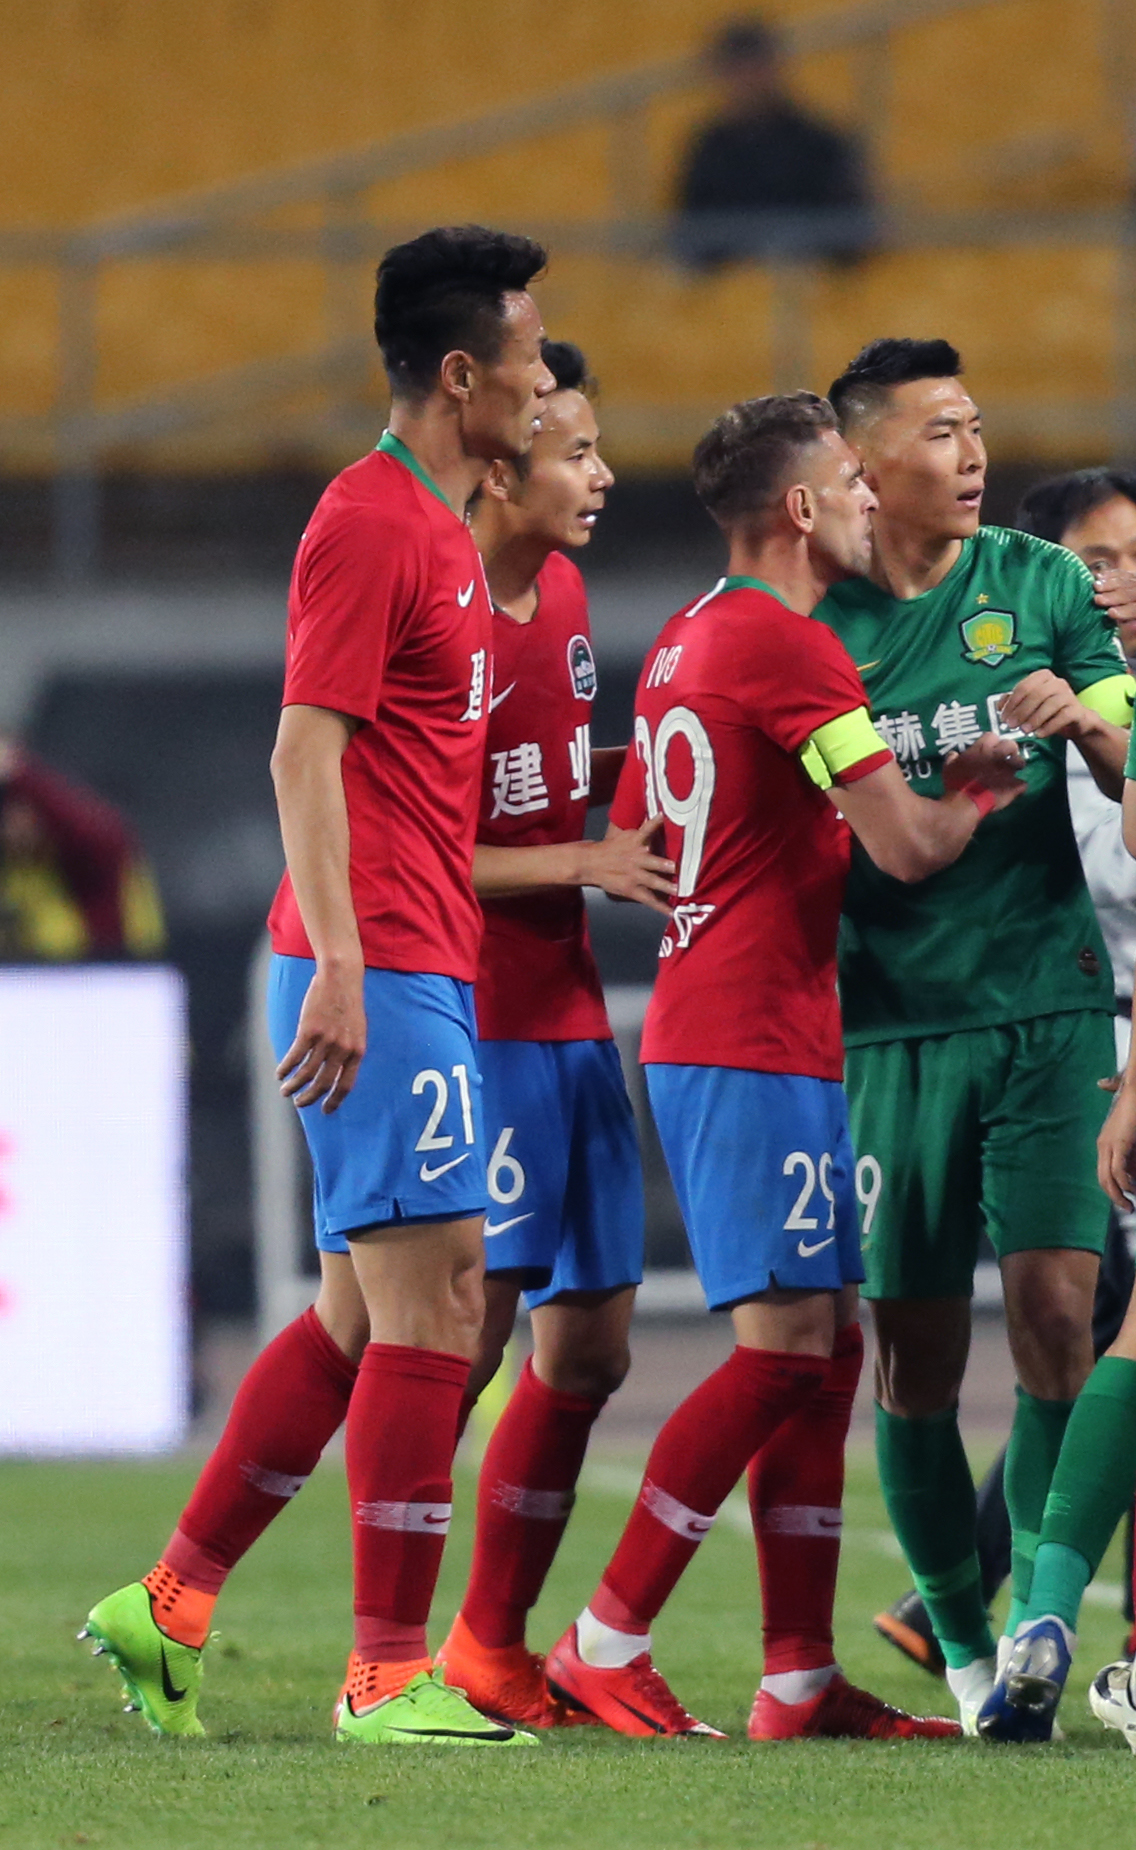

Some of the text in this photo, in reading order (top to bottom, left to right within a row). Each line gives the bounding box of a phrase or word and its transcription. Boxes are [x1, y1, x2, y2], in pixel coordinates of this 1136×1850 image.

[646, 645, 684, 689] IVO
[411, 1064, 475, 1152] 21
[855, 1154, 882, 1234] 9
